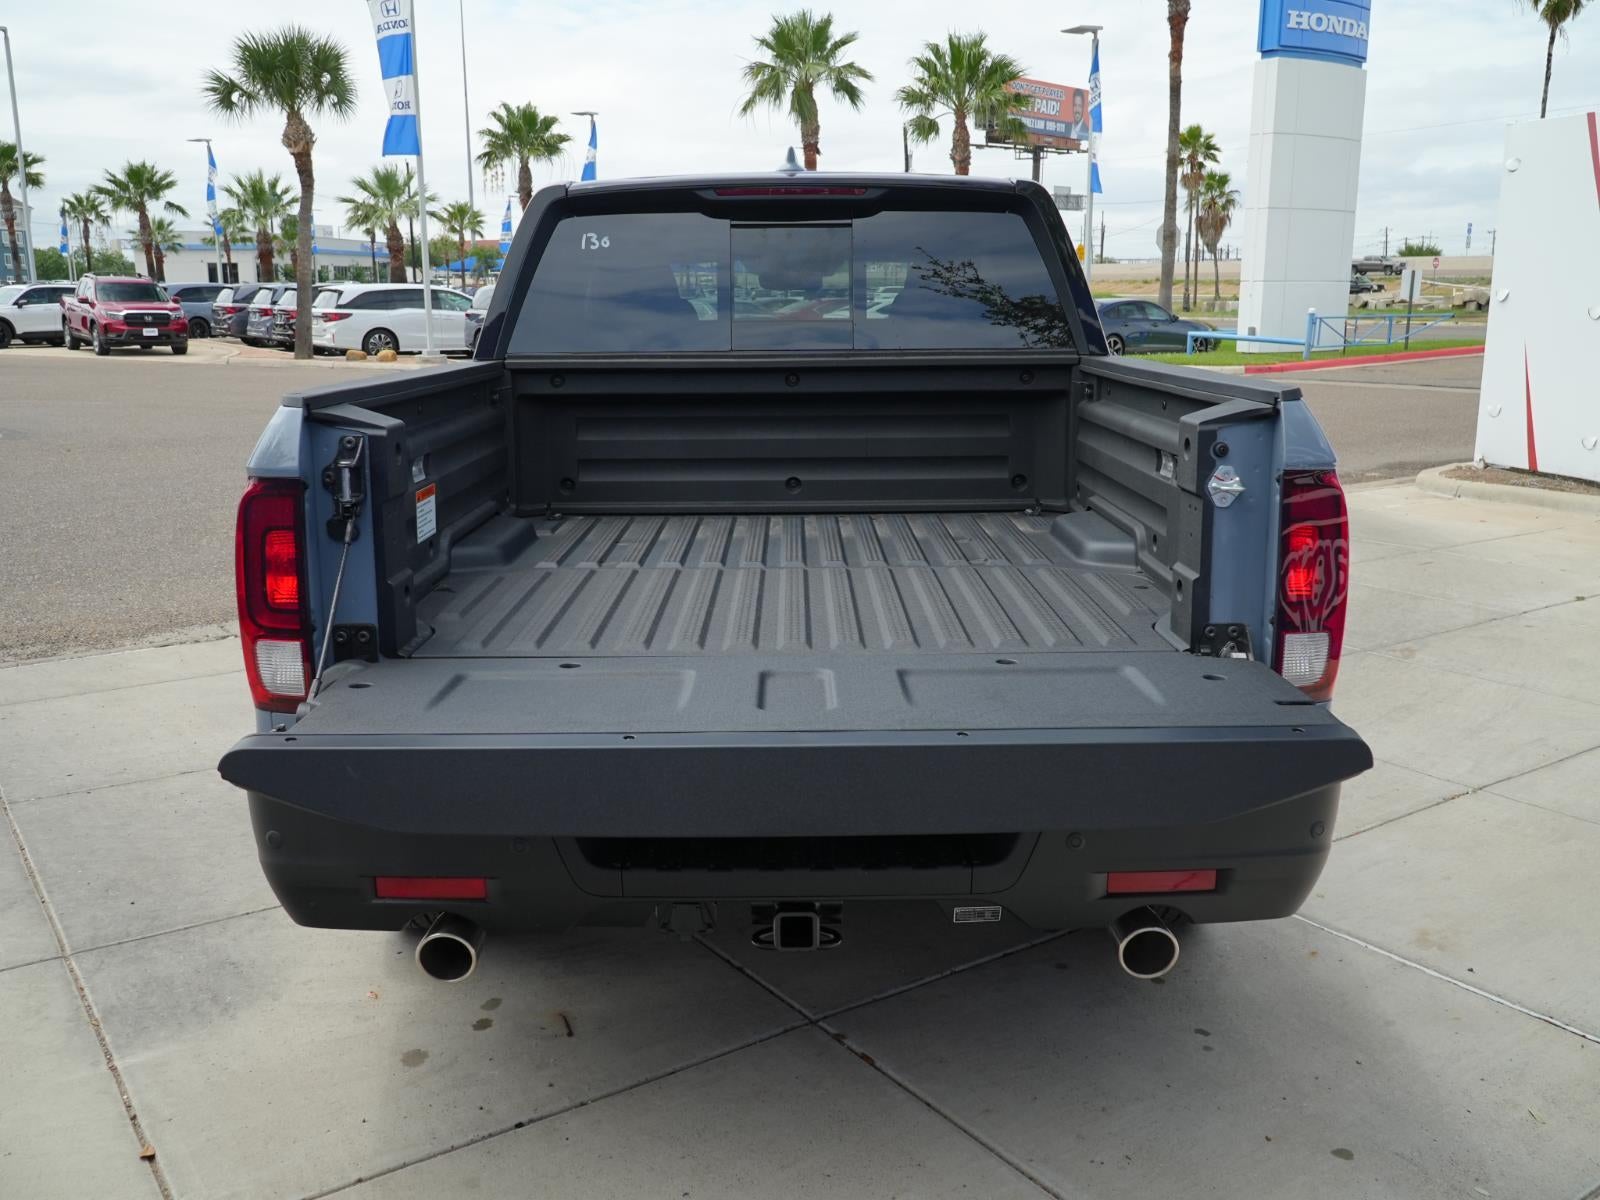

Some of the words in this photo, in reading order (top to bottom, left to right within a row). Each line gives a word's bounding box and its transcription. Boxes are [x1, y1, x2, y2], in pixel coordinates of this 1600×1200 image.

[1286, 10, 1369, 40] HONDA
[1034, 98, 1060, 116] PAID!
[581, 232, 610, 250] 136
